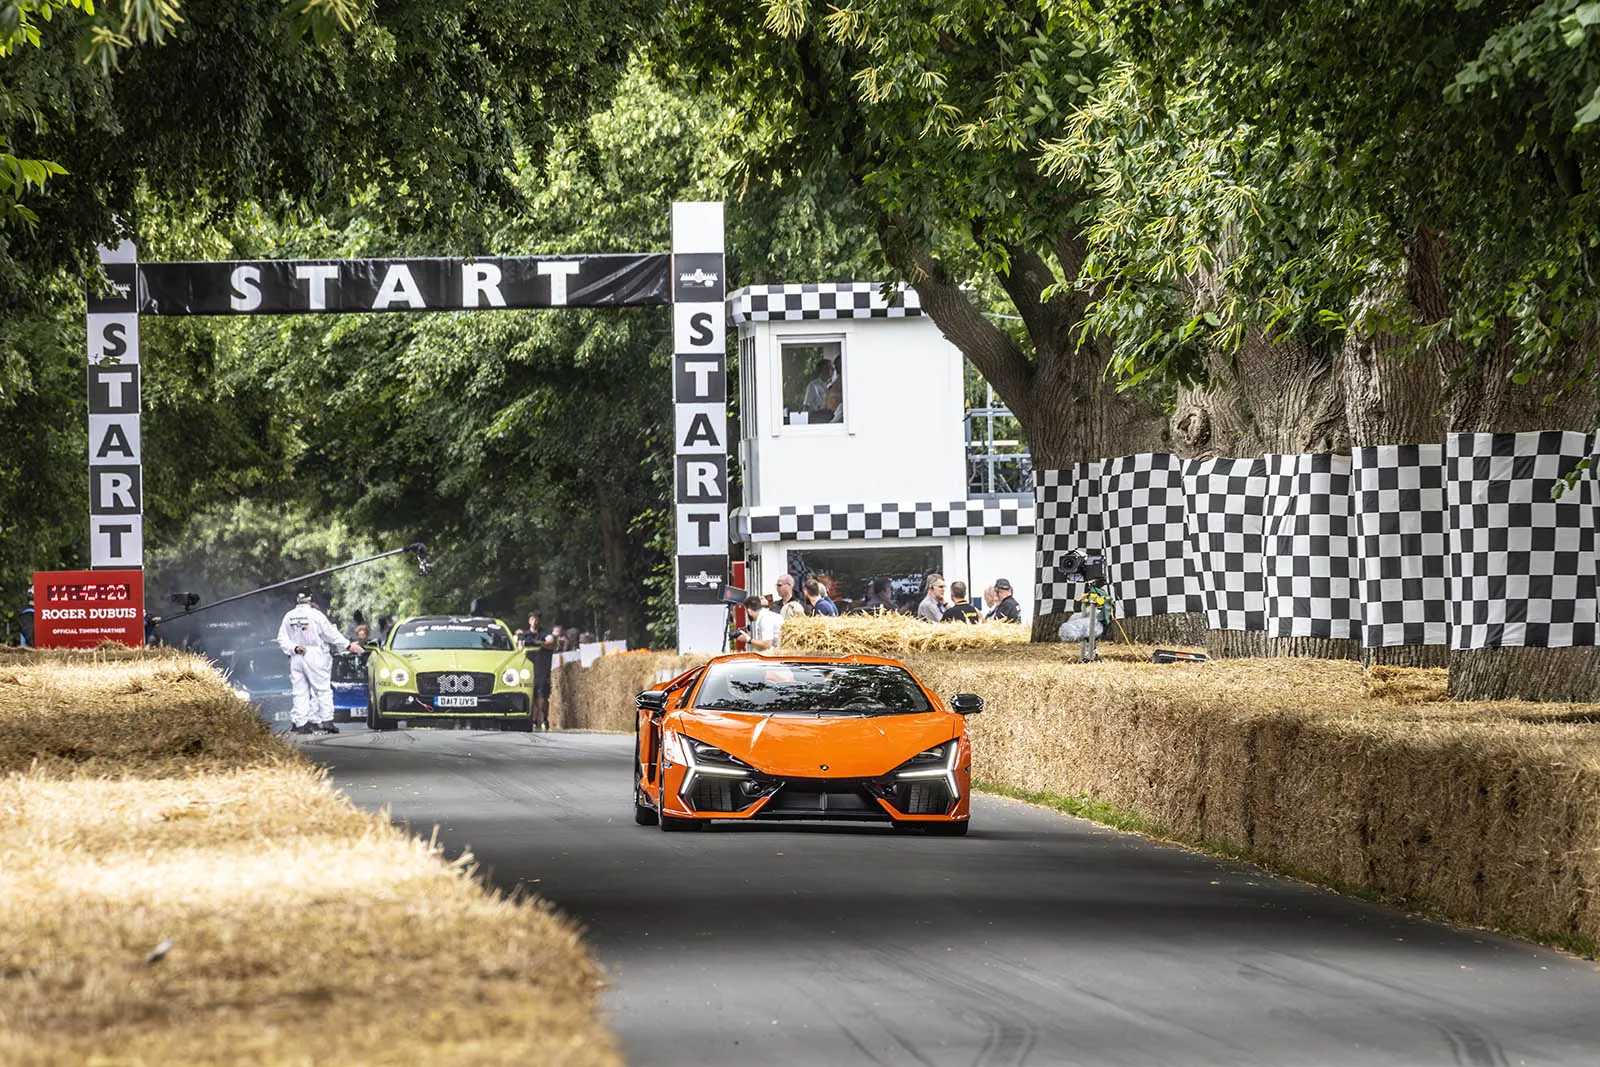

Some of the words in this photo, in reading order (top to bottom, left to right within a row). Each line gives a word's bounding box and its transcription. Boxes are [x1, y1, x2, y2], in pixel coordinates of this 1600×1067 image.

[229, 261, 580, 311] START
[96, 322, 134, 558] START
[683, 312, 722, 548] START
[41, 609, 87, 619] ROGER
[89, 608, 136, 618] DUBUIS
[437, 674, 475, 693] 100
